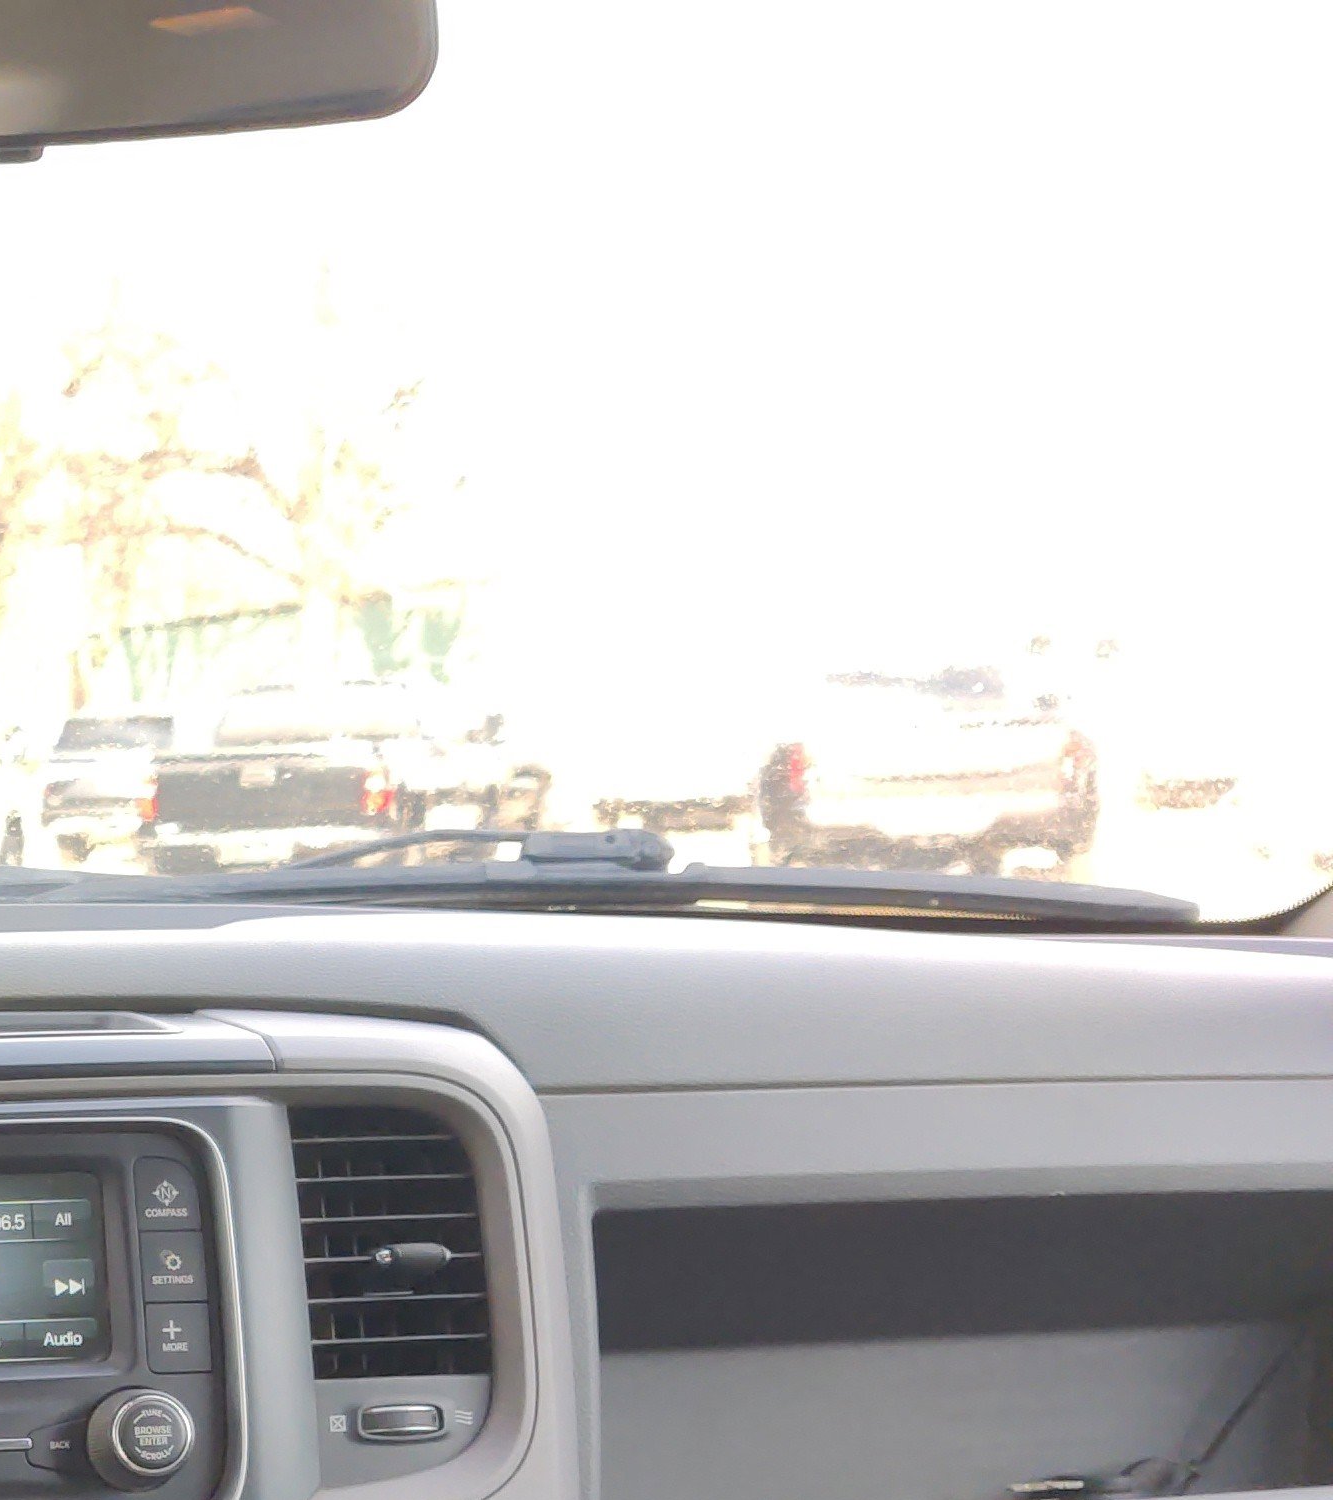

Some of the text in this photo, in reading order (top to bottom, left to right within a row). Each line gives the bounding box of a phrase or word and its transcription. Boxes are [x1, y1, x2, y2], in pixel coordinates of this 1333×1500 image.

[145, 1206, 189, 1218] COMPASS
[54, 1211, 72, 1226] All
[152, 1273, 194, 1285] SETTINGS
[44, 1330, 84, 1347] Audio
[162, 1341, 189, 1352] MORE
[133, 1425, 172, 1435] BROWSE
[139, 1436, 168, 1446] ENTER
